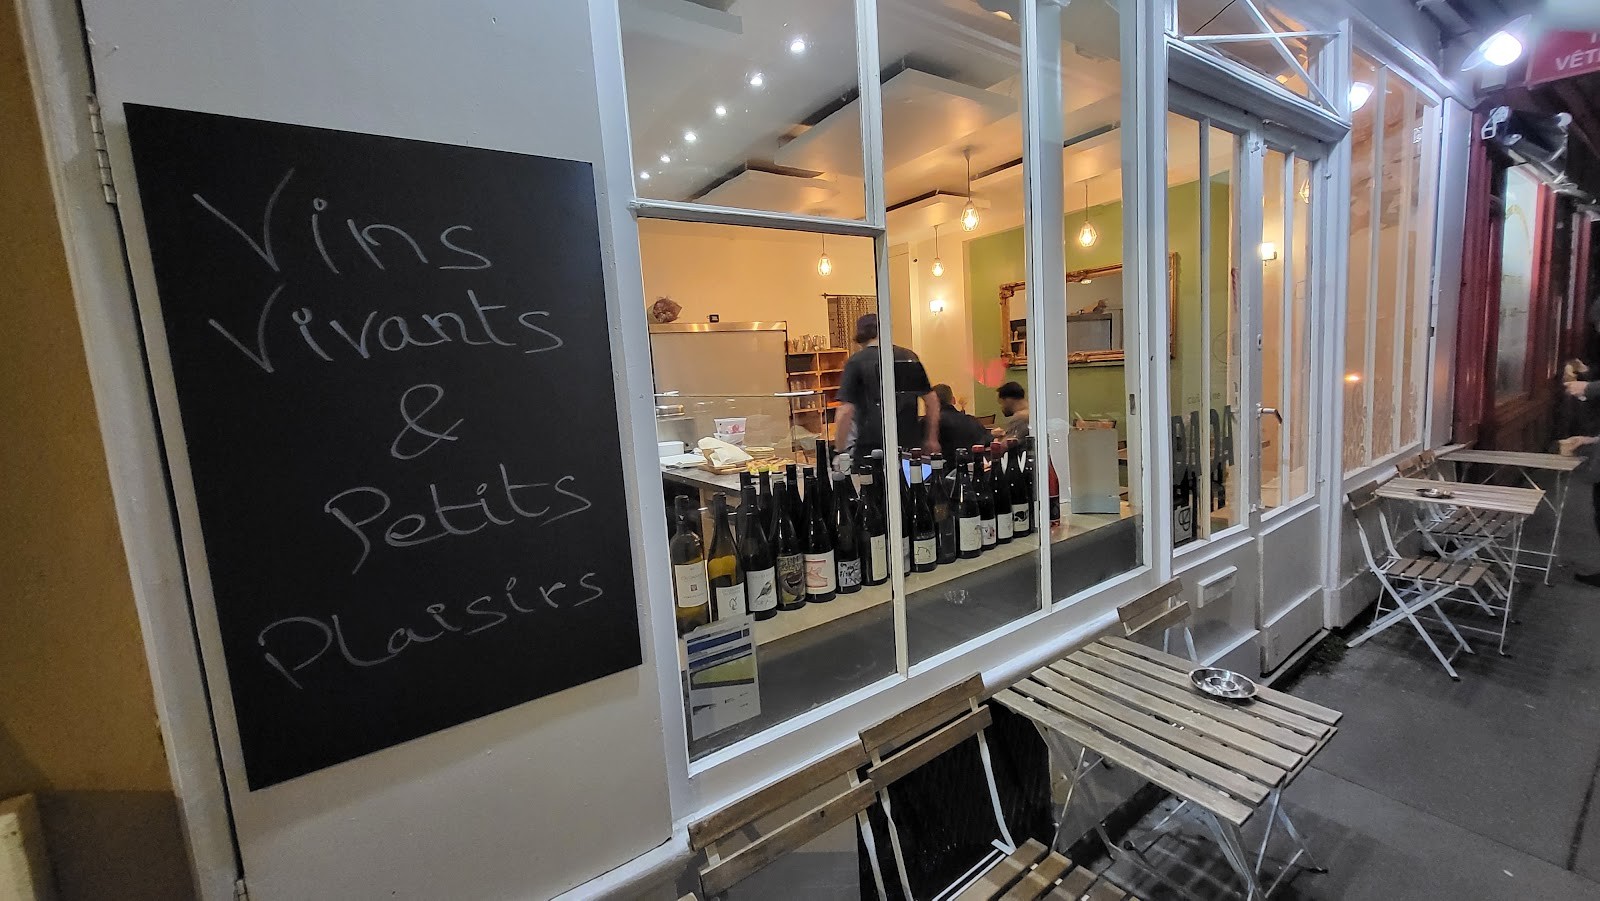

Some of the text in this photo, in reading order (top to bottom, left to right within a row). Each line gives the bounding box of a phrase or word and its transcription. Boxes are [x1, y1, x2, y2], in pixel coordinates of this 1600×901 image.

[1555, 48, 1600, 71] VÊT
[192, 168, 492, 273] Vins
[208, 286, 563, 373] Vivants
[391, 384, 464, 460] &
[324, 463, 591, 574] Petits
[258, 573, 603, 689] Plaisirs
